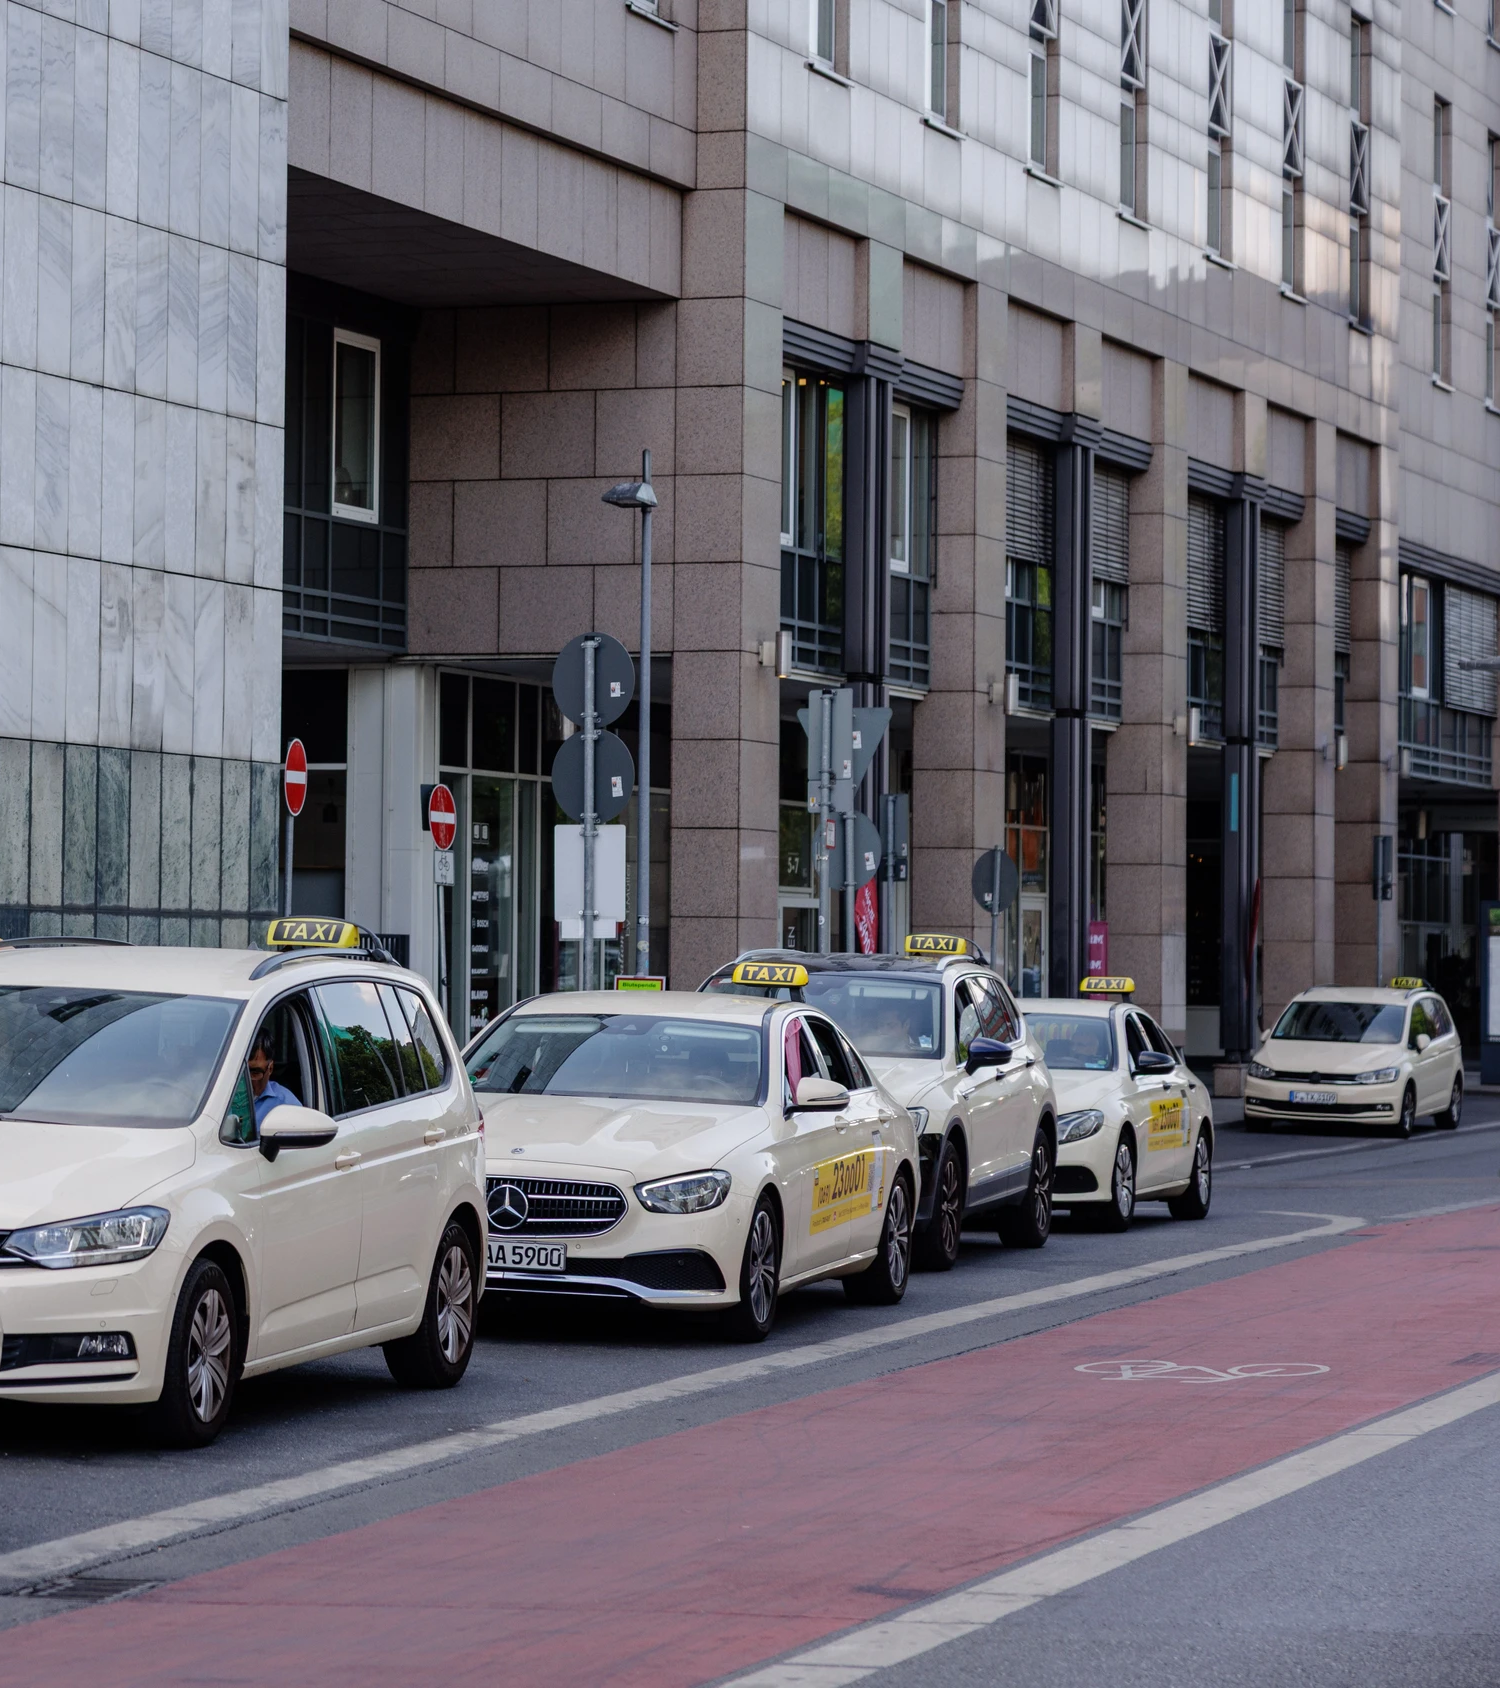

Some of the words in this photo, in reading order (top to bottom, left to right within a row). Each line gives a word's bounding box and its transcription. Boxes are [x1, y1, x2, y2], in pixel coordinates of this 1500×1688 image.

[282, 922, 338, 941] TAXI
[915, 937, 954, 950] TAXI
[745, 966, 794, 982] TAXI
[1089, 979, 1125, 989] TAXI
[511, 1245, 561, 1267] 5900
